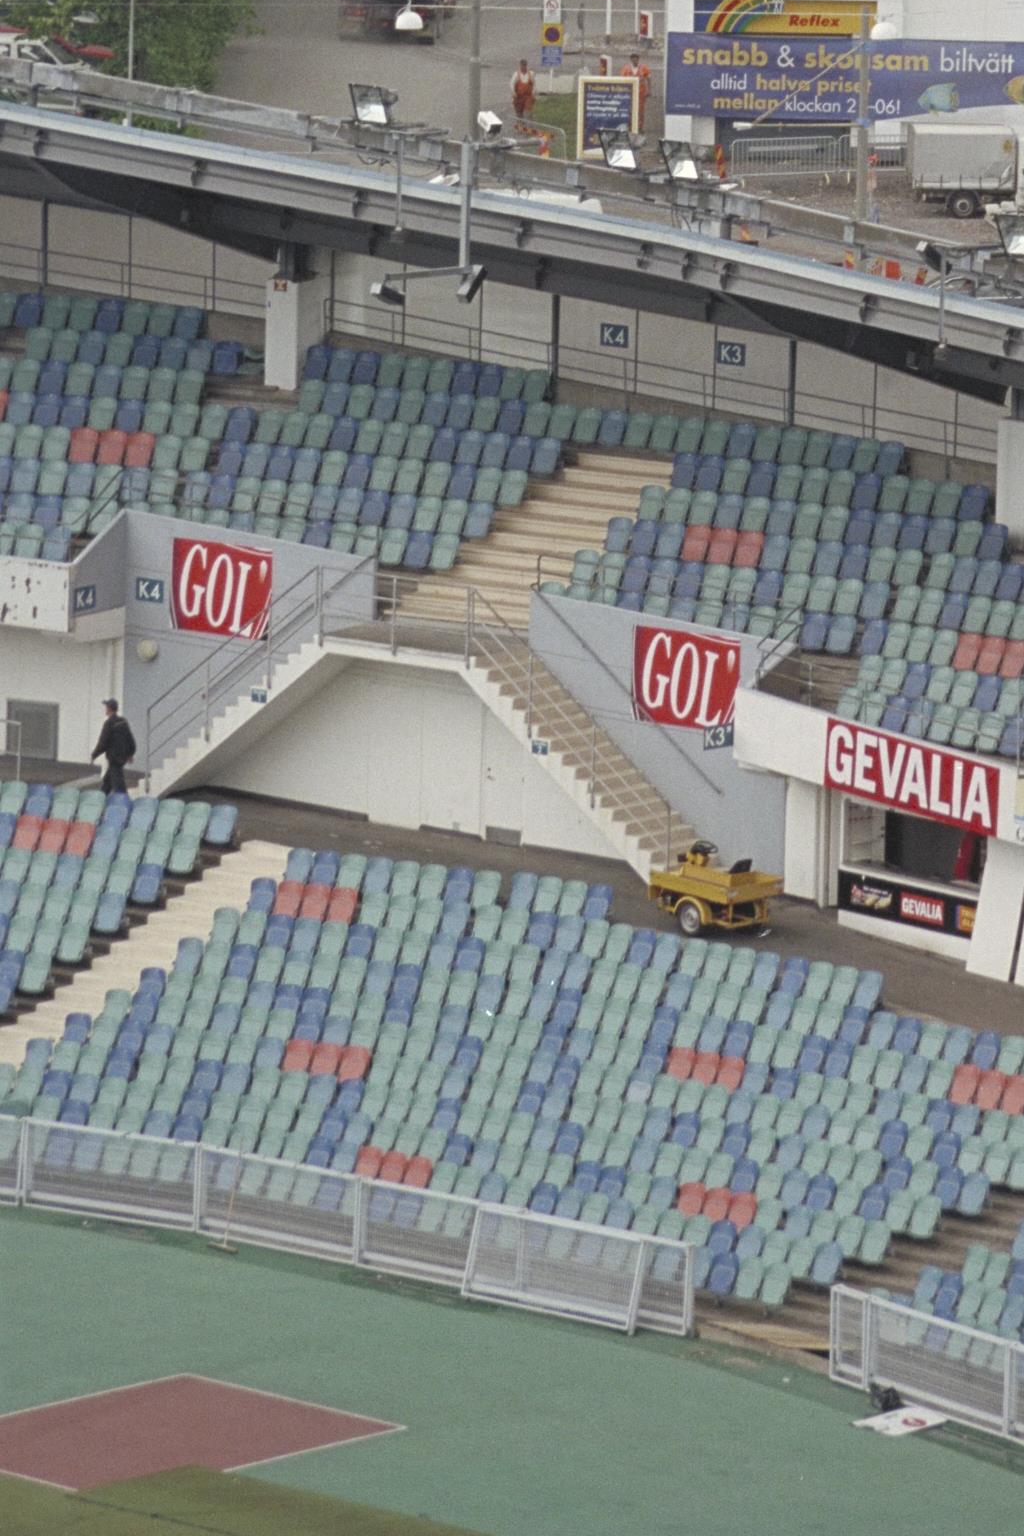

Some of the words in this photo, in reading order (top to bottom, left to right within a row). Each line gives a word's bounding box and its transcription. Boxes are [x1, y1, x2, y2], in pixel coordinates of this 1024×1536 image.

[788, 14, 841, 27] Reflex
[682, 41, 769, 67] snabb
[776, 44, 795, 68] &
[939, 47, 1016, 73] biltvätt
[710, 73, 748, 91] alltid
[755, 74, 812, 92] halva
[713, 93, 779, 111] mellan
[784, 96, 841, 113] klockan
[603, 327, 625, 345] K4
[720, 345, 742, 363] K3
[76, 589, 94, 610] K4
[138, 581, 161, 600] K4
[827, 724, 993, 829] GEVALIA
[902, 897, 943, 922] GEVALIA
